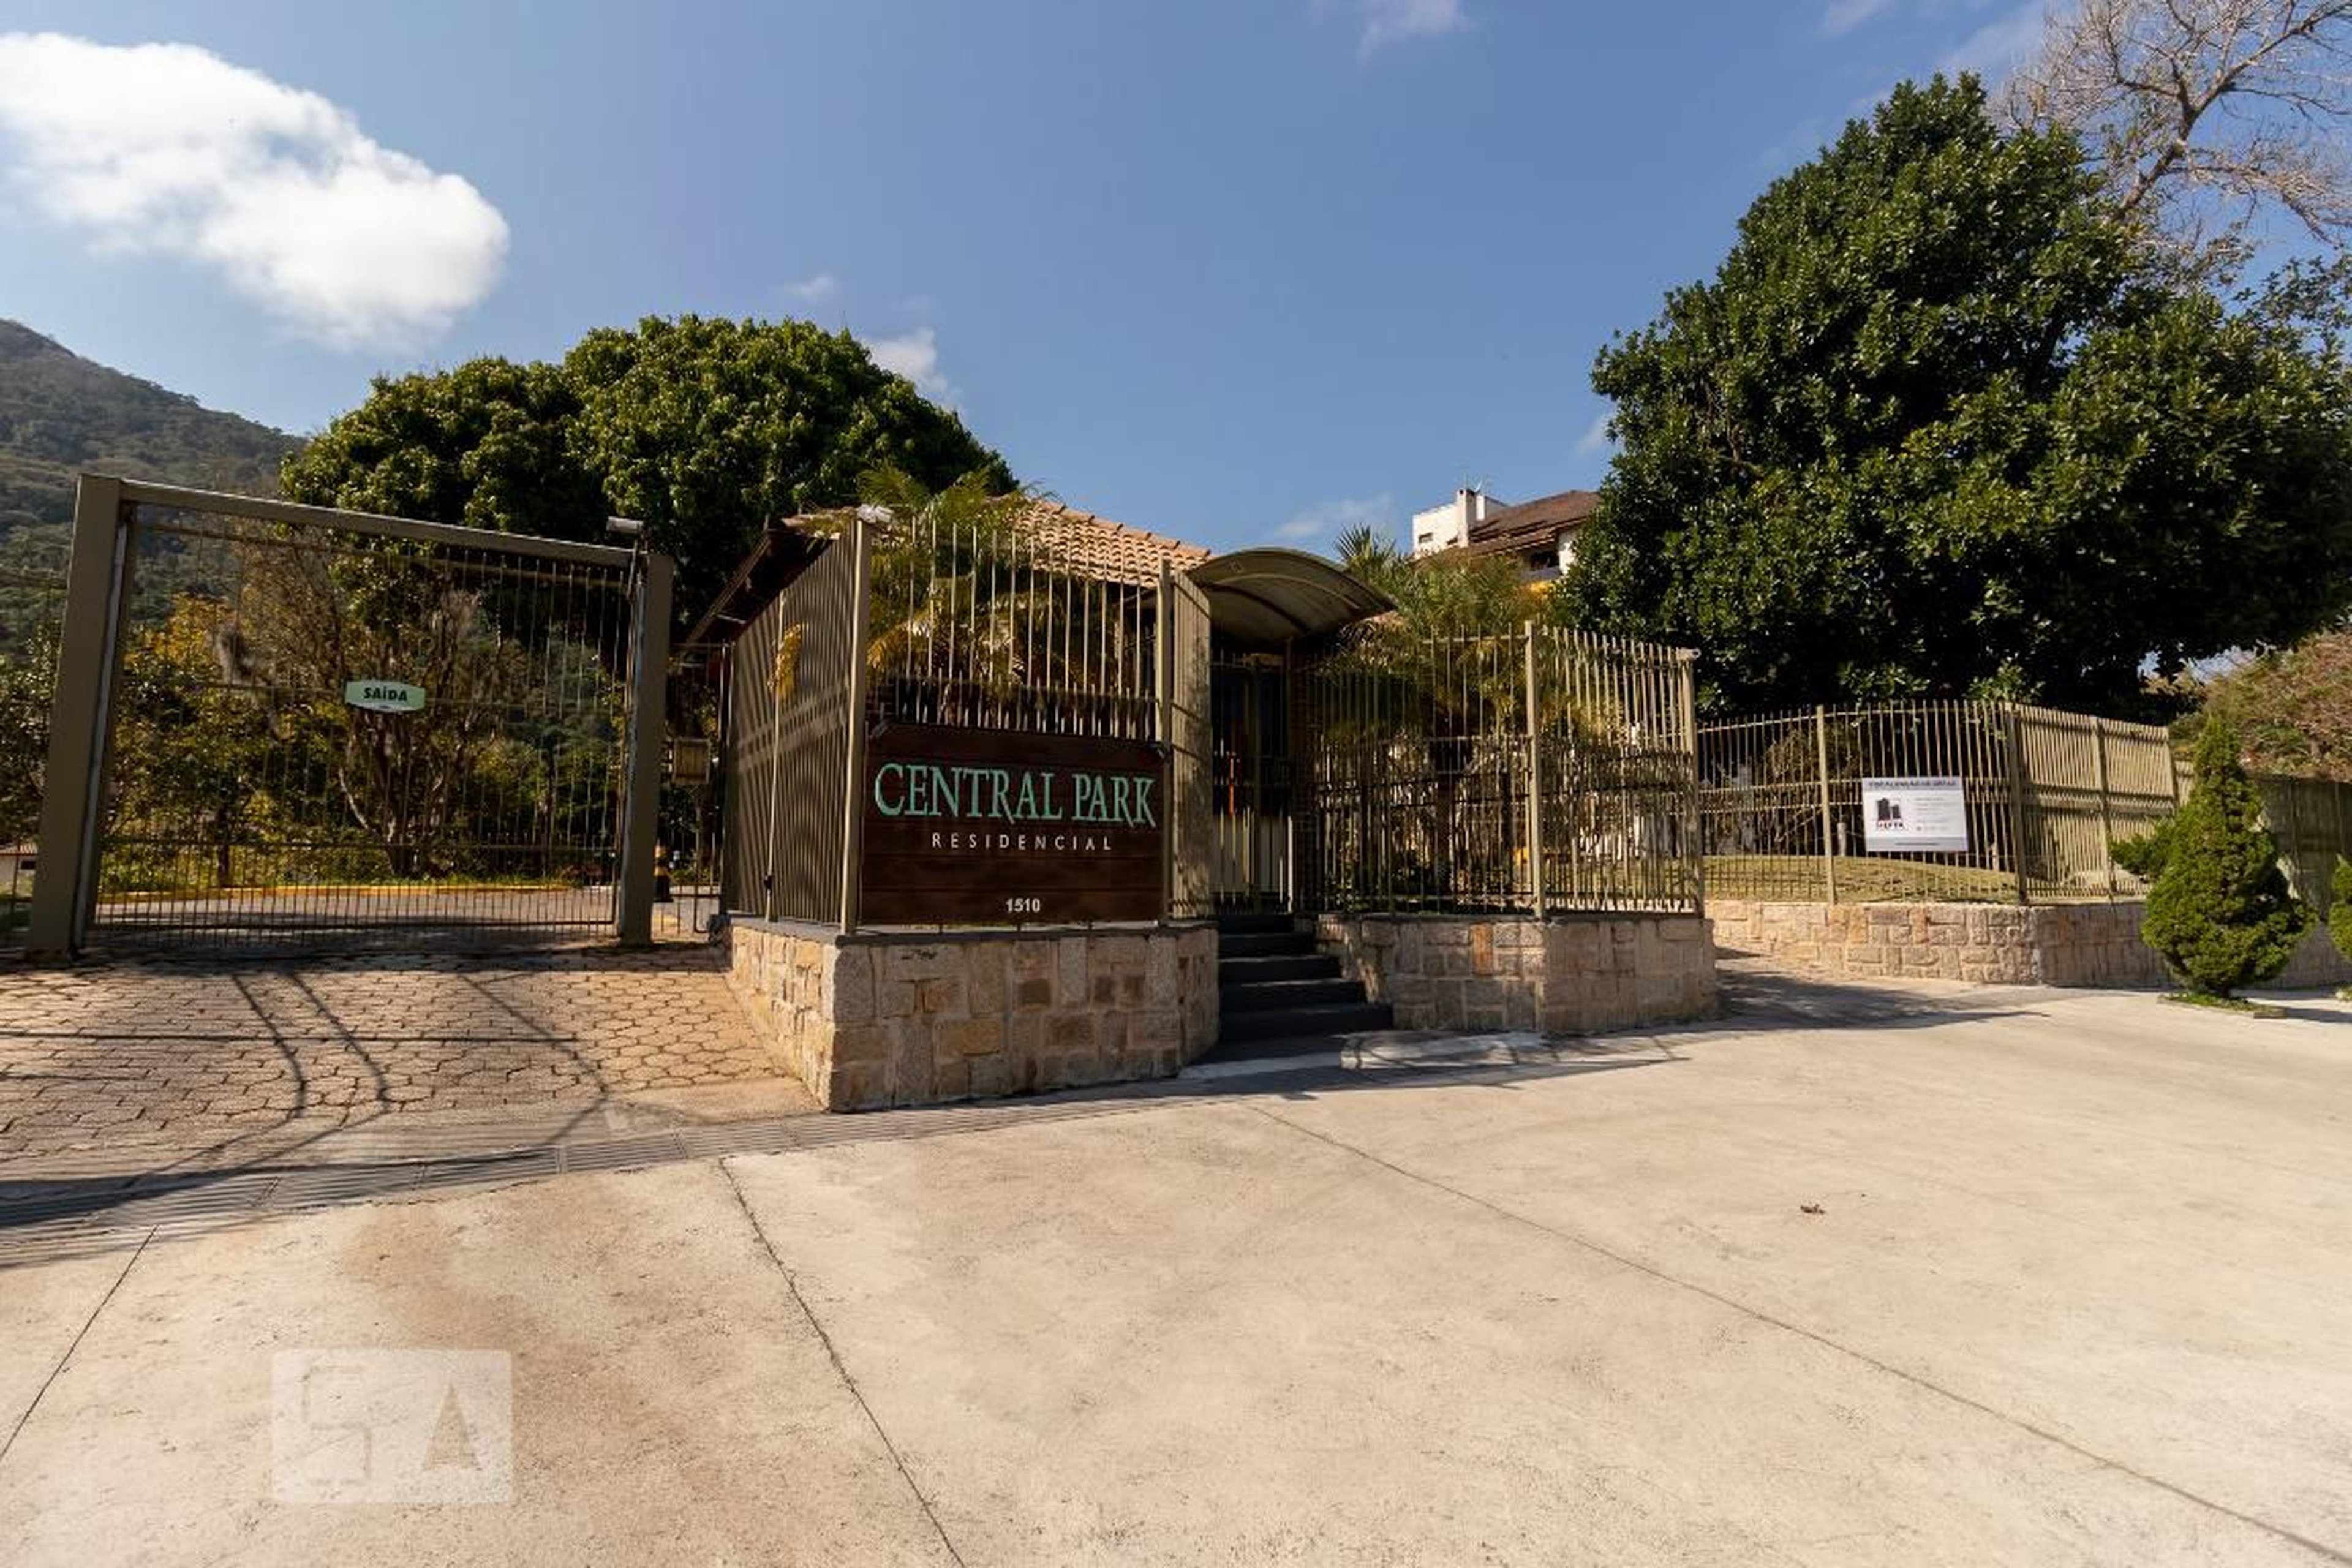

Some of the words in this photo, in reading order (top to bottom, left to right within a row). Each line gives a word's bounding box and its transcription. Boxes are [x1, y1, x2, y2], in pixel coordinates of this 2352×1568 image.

[364, 685, 407, 701] SAÍDA
[875, 763, 1062, 824] CENTRAL
[1072, 773, 1156, 828] PARK
[932, 833, 1112, 851] RESIDENCIAL
[1005, 898, 1041, 913] 1510
